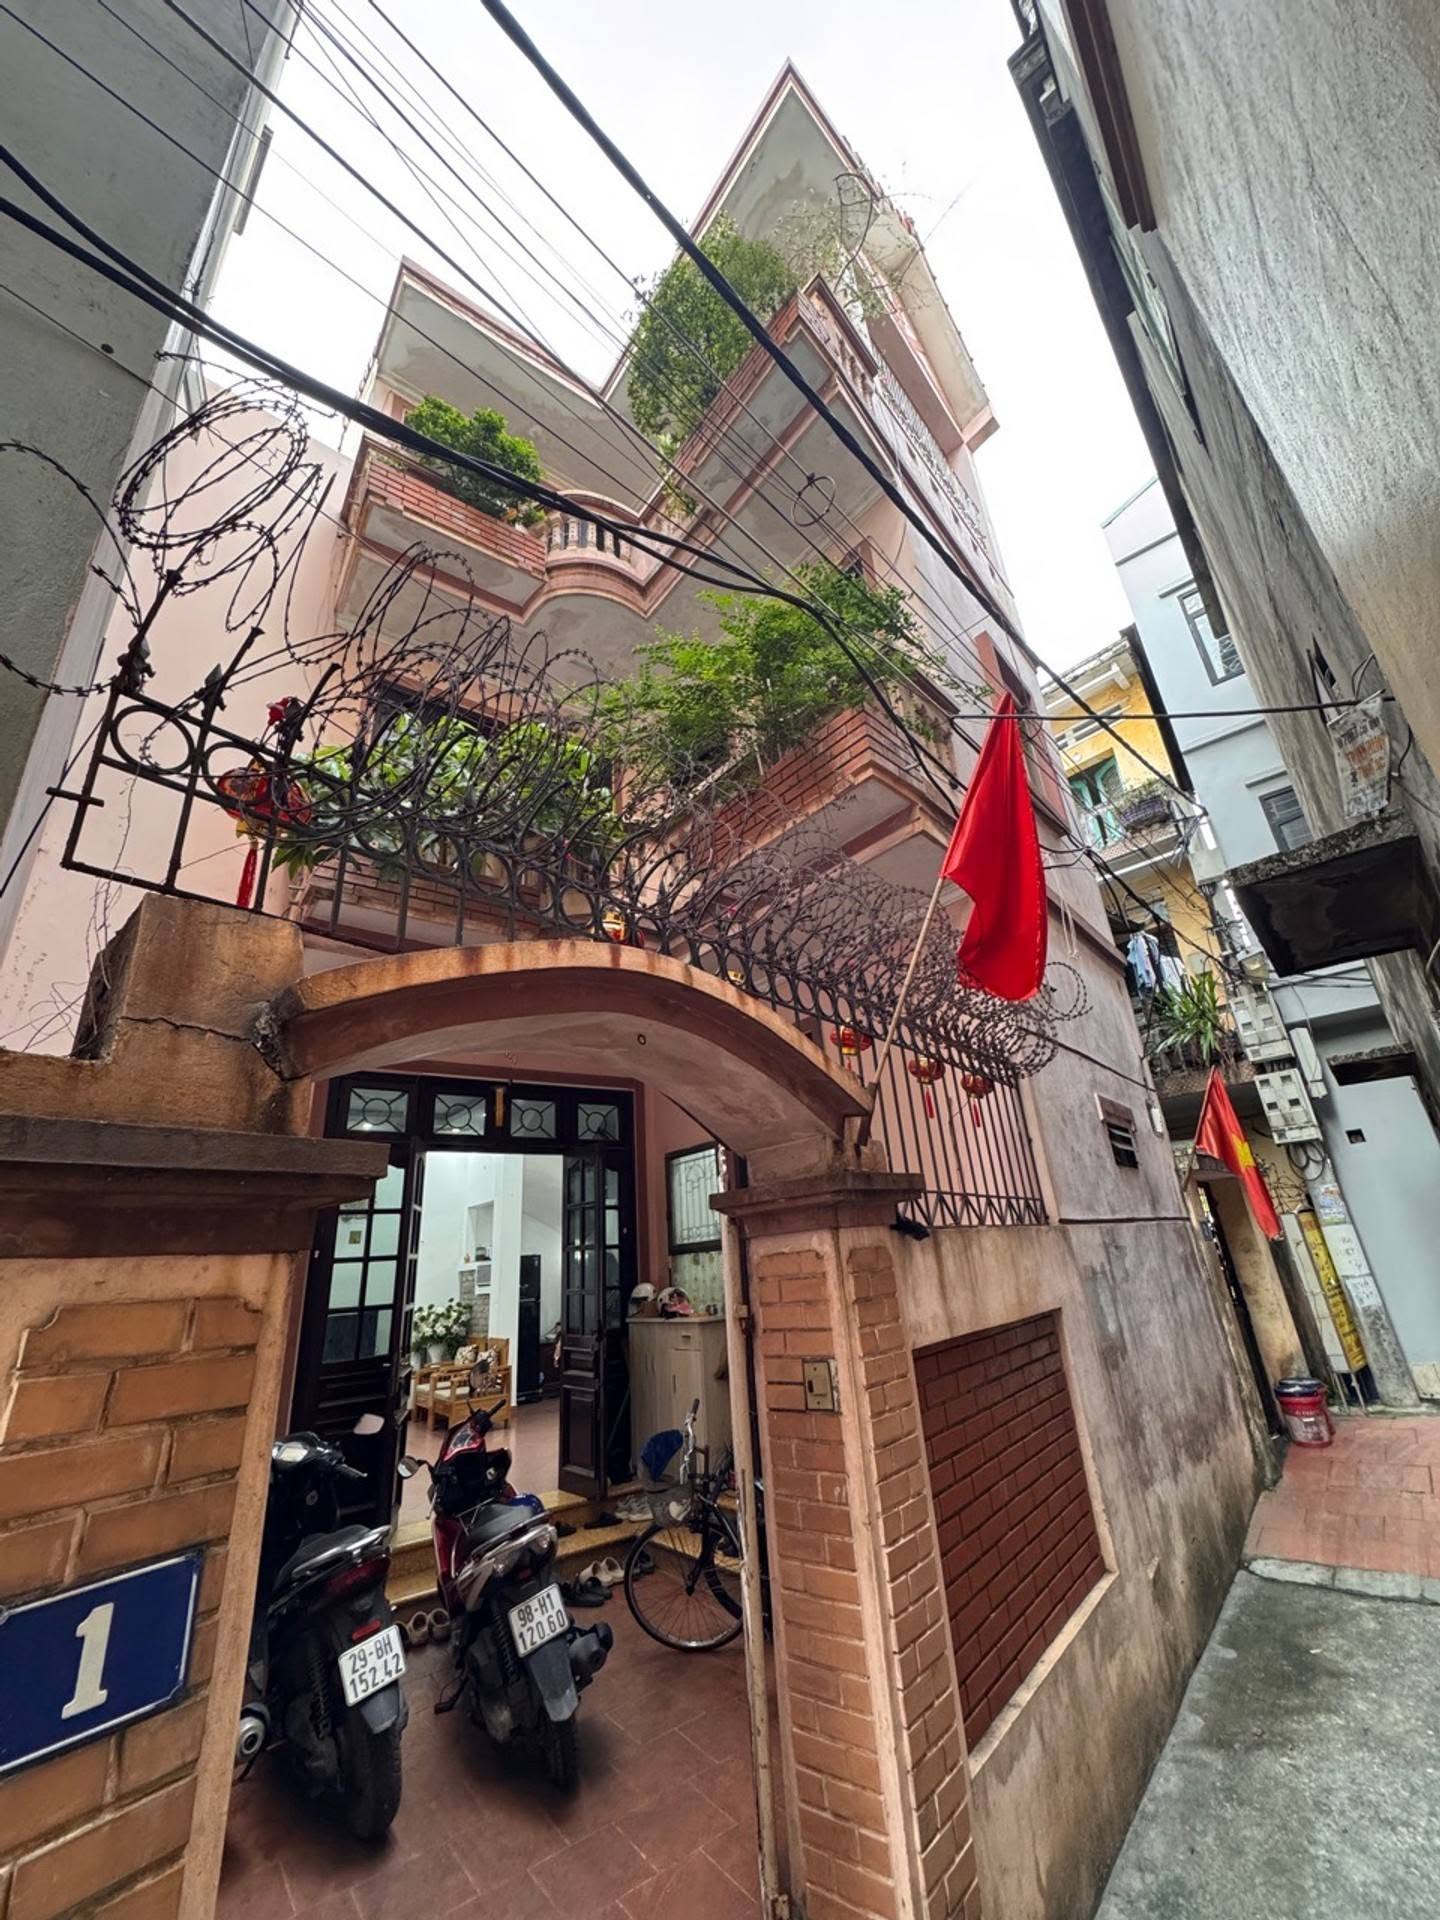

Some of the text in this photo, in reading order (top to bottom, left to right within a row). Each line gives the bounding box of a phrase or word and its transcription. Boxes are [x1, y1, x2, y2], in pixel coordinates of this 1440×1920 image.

[517, 1592, 555, 1628] 98-H1
[518, 1608, 566, 1651] 120.60
[61, 1602, 115, 1720] 1
[348, 1634, 393, 1675] 29-BH
[349, 1652, 404, 1699] 152.42
